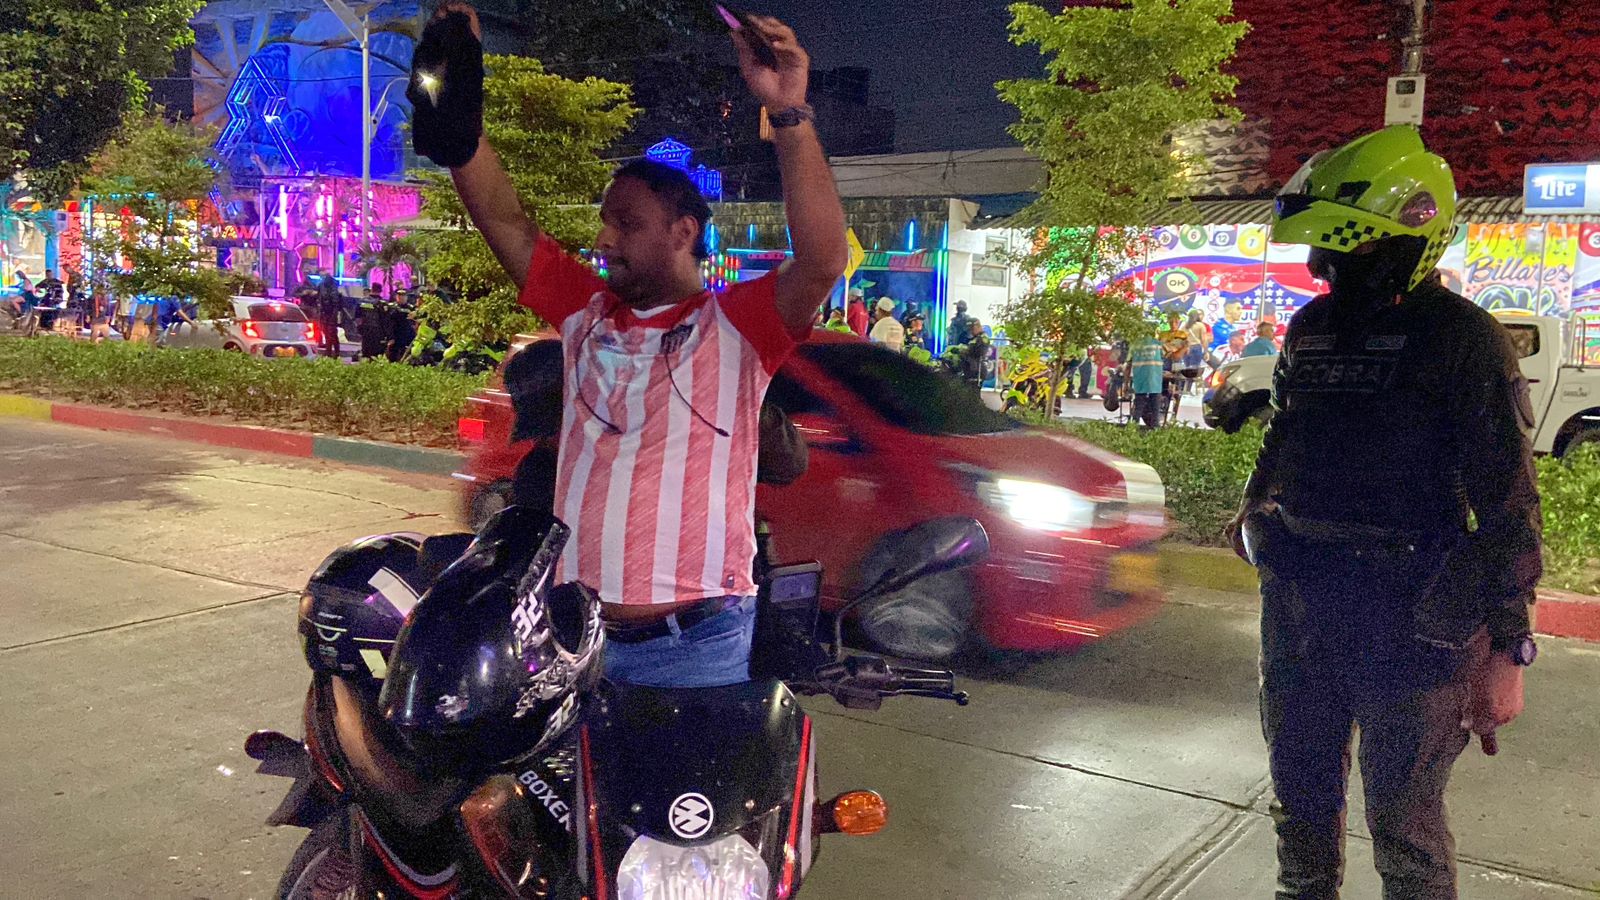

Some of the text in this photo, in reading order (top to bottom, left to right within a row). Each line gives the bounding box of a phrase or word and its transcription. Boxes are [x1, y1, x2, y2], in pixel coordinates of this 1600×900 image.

[1531, 175, 1577, 200] Lite
[1191, 231, 1197, 240] 6
[1218, 234, 1227, 243] 12
[1467, 256, 1574, 283] Billares
[1169, 279, 1186, 287] OK
[1241, 311, 1292, 321] JUOR
